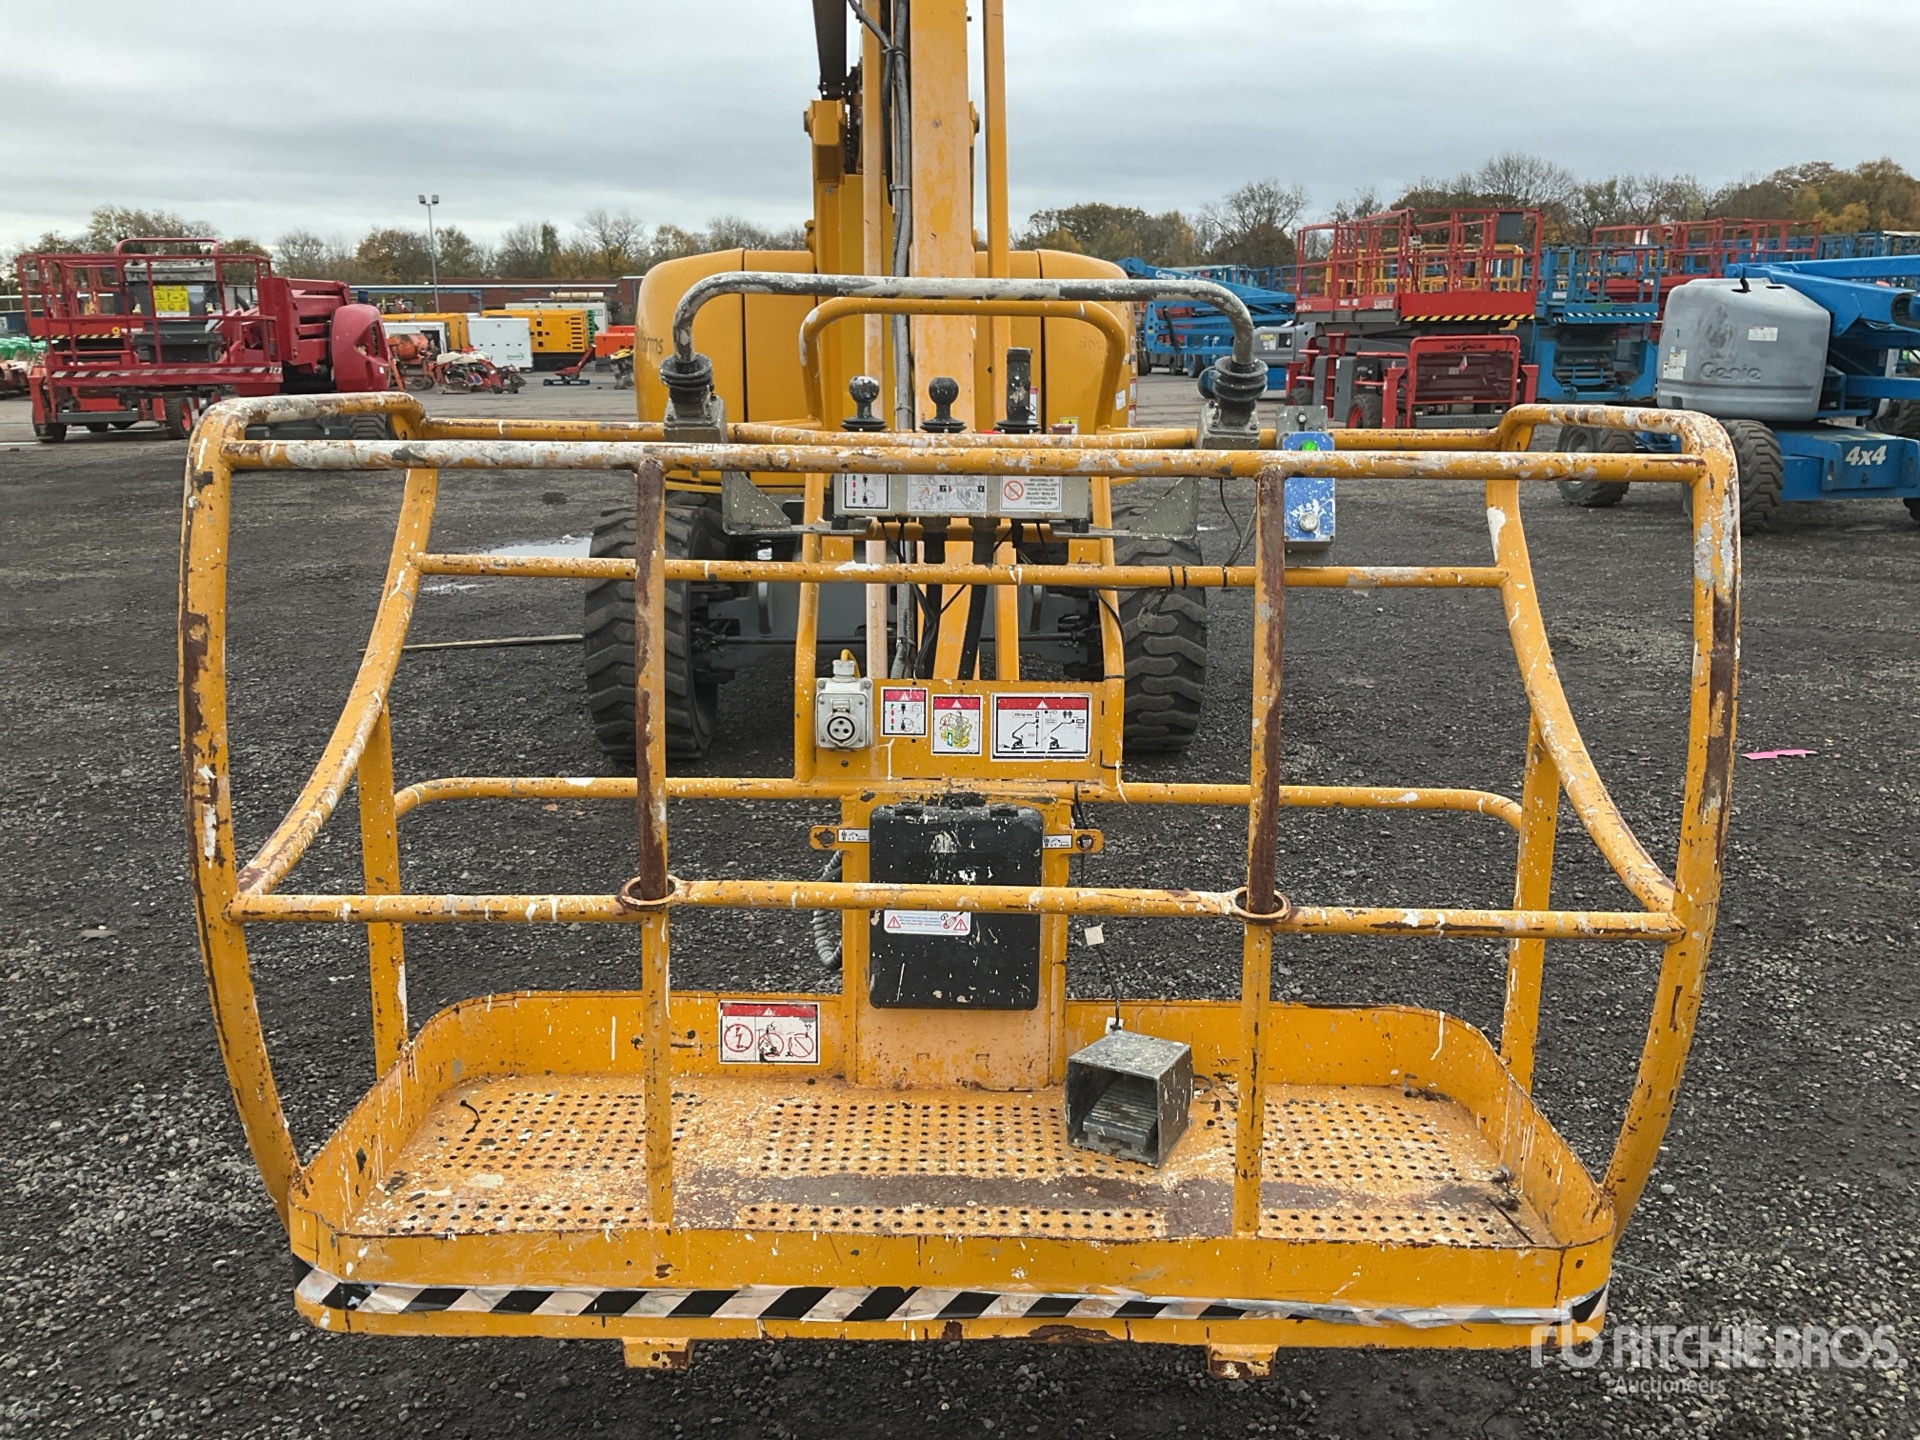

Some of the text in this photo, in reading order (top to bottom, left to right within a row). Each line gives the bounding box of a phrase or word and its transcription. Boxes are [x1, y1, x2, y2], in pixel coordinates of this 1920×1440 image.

[1444, 342, 1486, 350] SKYJACK
[1700, 361, 1762, 382] Genie
[1845, 445, 1887, 466] 4x4
[1289, 503, 1327, 518] REST
